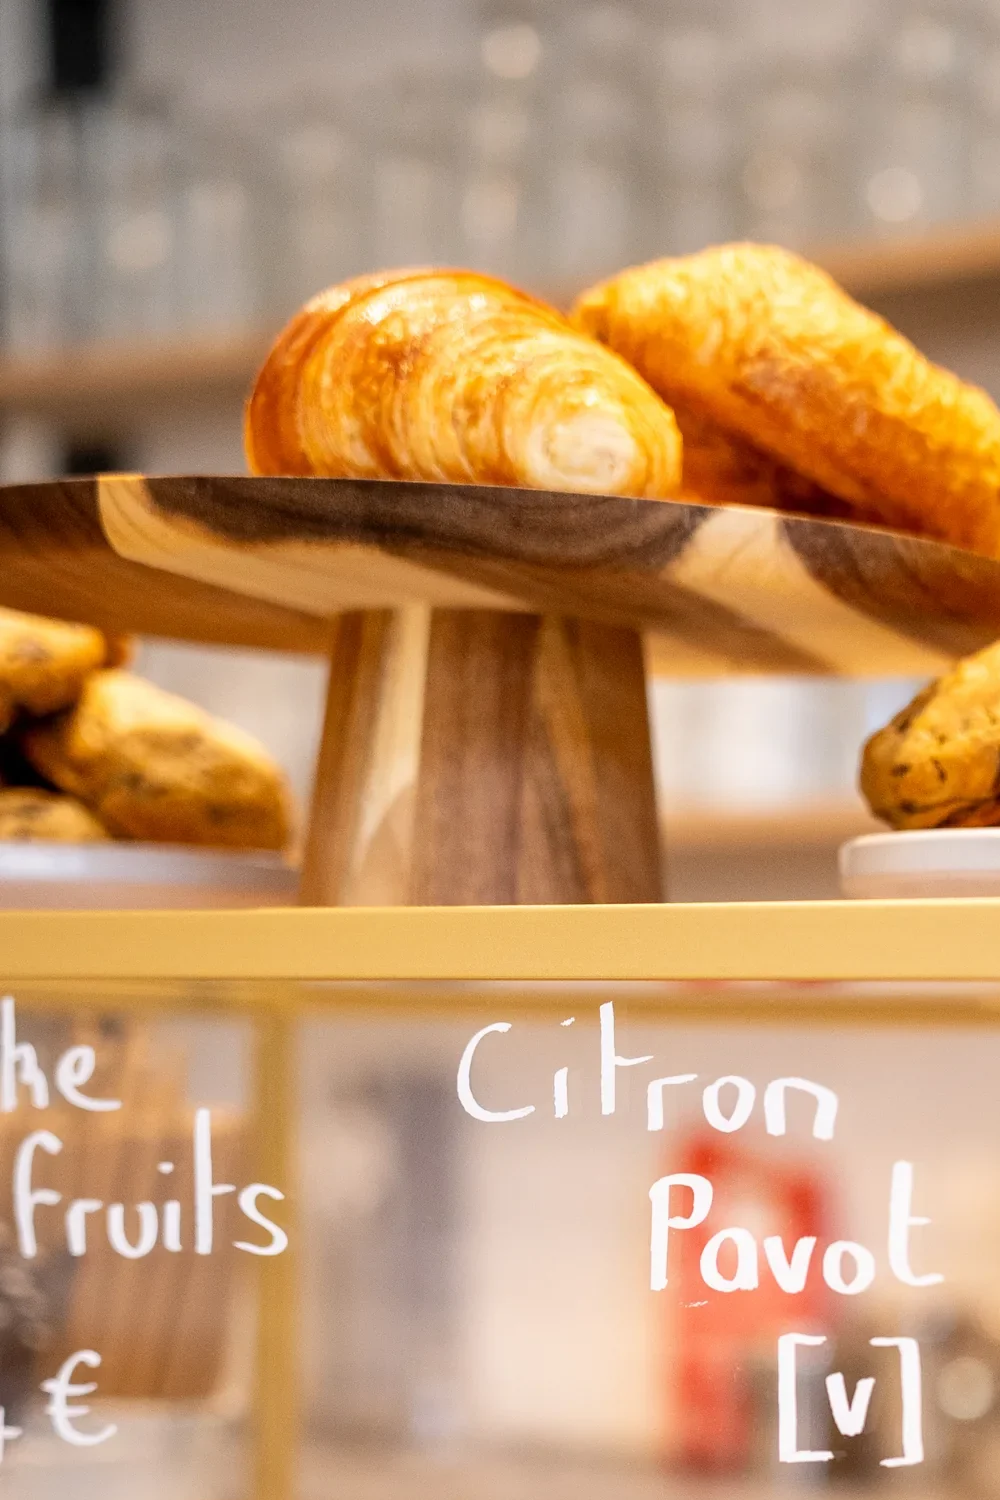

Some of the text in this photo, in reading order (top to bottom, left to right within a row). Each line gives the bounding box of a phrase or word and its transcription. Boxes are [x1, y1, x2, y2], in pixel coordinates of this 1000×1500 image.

[457, 1002, 838, 1141] Citron
[12, 1107, 289, 1259] fruits
[648, 1160, 944, 1294] Pavot
